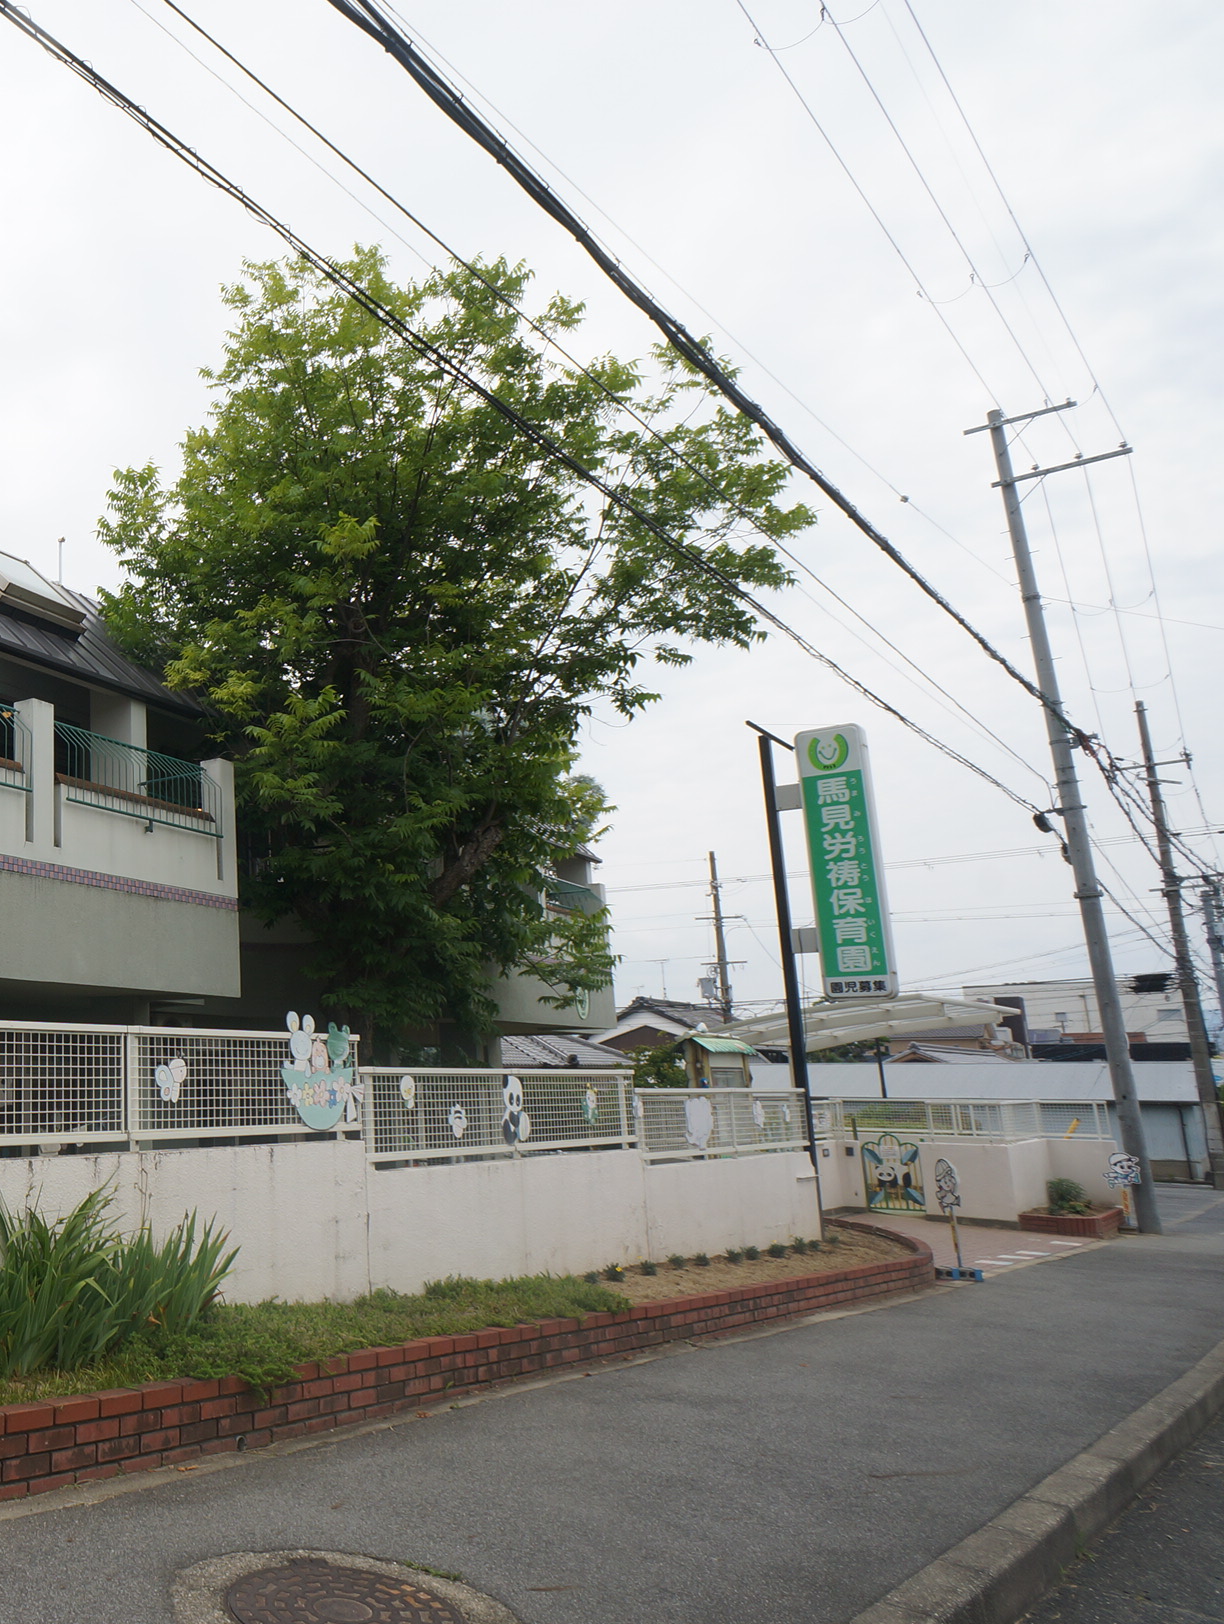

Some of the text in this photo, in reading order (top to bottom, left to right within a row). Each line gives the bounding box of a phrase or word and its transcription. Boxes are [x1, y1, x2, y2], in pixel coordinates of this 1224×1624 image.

[817, 776, 872, 972] 馬見労祷保育園
[830, 980, 887, 993] 園児募集
